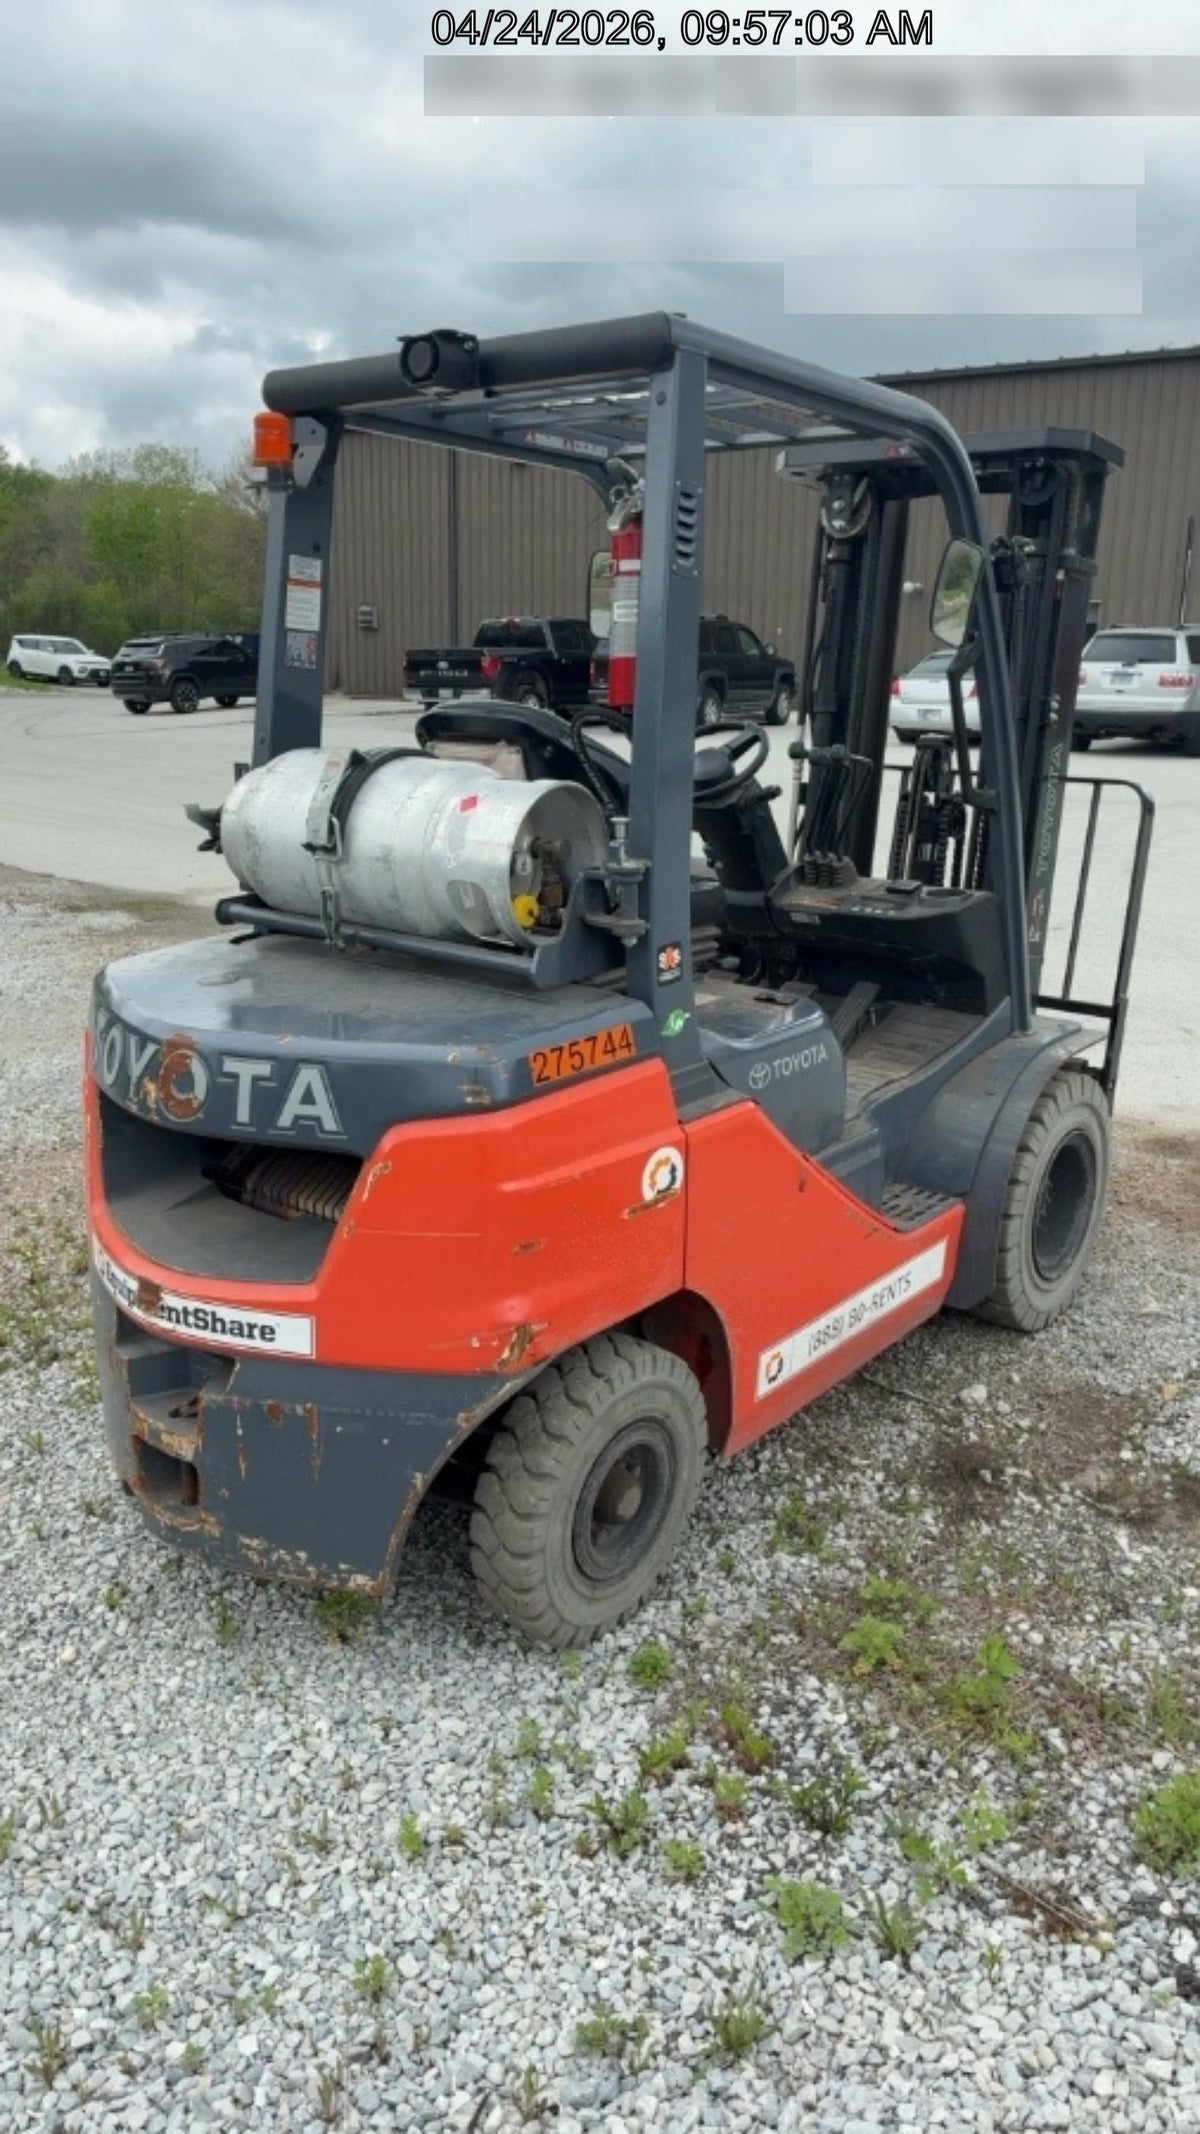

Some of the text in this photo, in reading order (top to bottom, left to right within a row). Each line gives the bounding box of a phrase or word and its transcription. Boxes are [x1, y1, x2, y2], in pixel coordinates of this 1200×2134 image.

[1036, 742, 1064, 878] TOYOTA
[532, 1025, 632, 1084] 275744
[772, 1043, 828, 1080] TOYOTA
